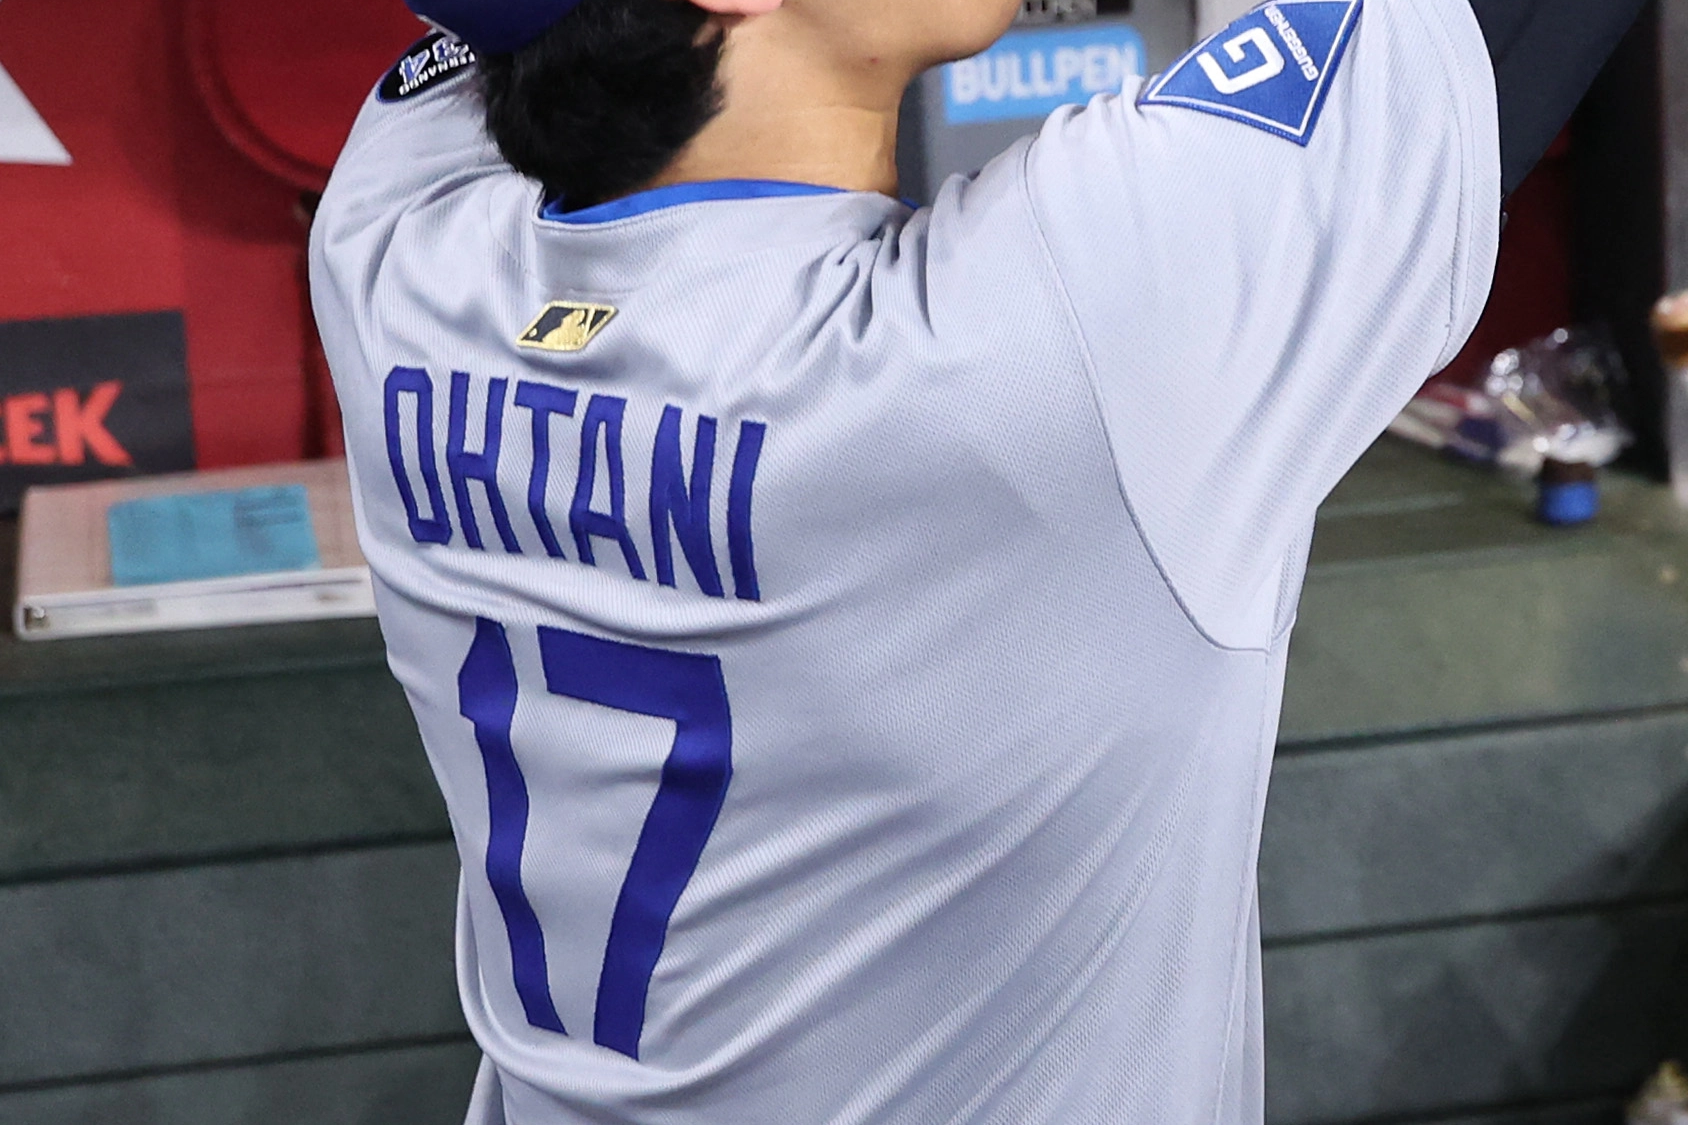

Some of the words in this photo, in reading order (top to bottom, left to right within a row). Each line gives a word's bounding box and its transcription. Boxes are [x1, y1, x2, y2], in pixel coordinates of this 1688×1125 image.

[952, 43, 1139, 104] BULLPEN
[0, 378, 136, 466] EK
[383, 364, 768, 602] OHTANI
[457, 615, 735, 1061] 17
